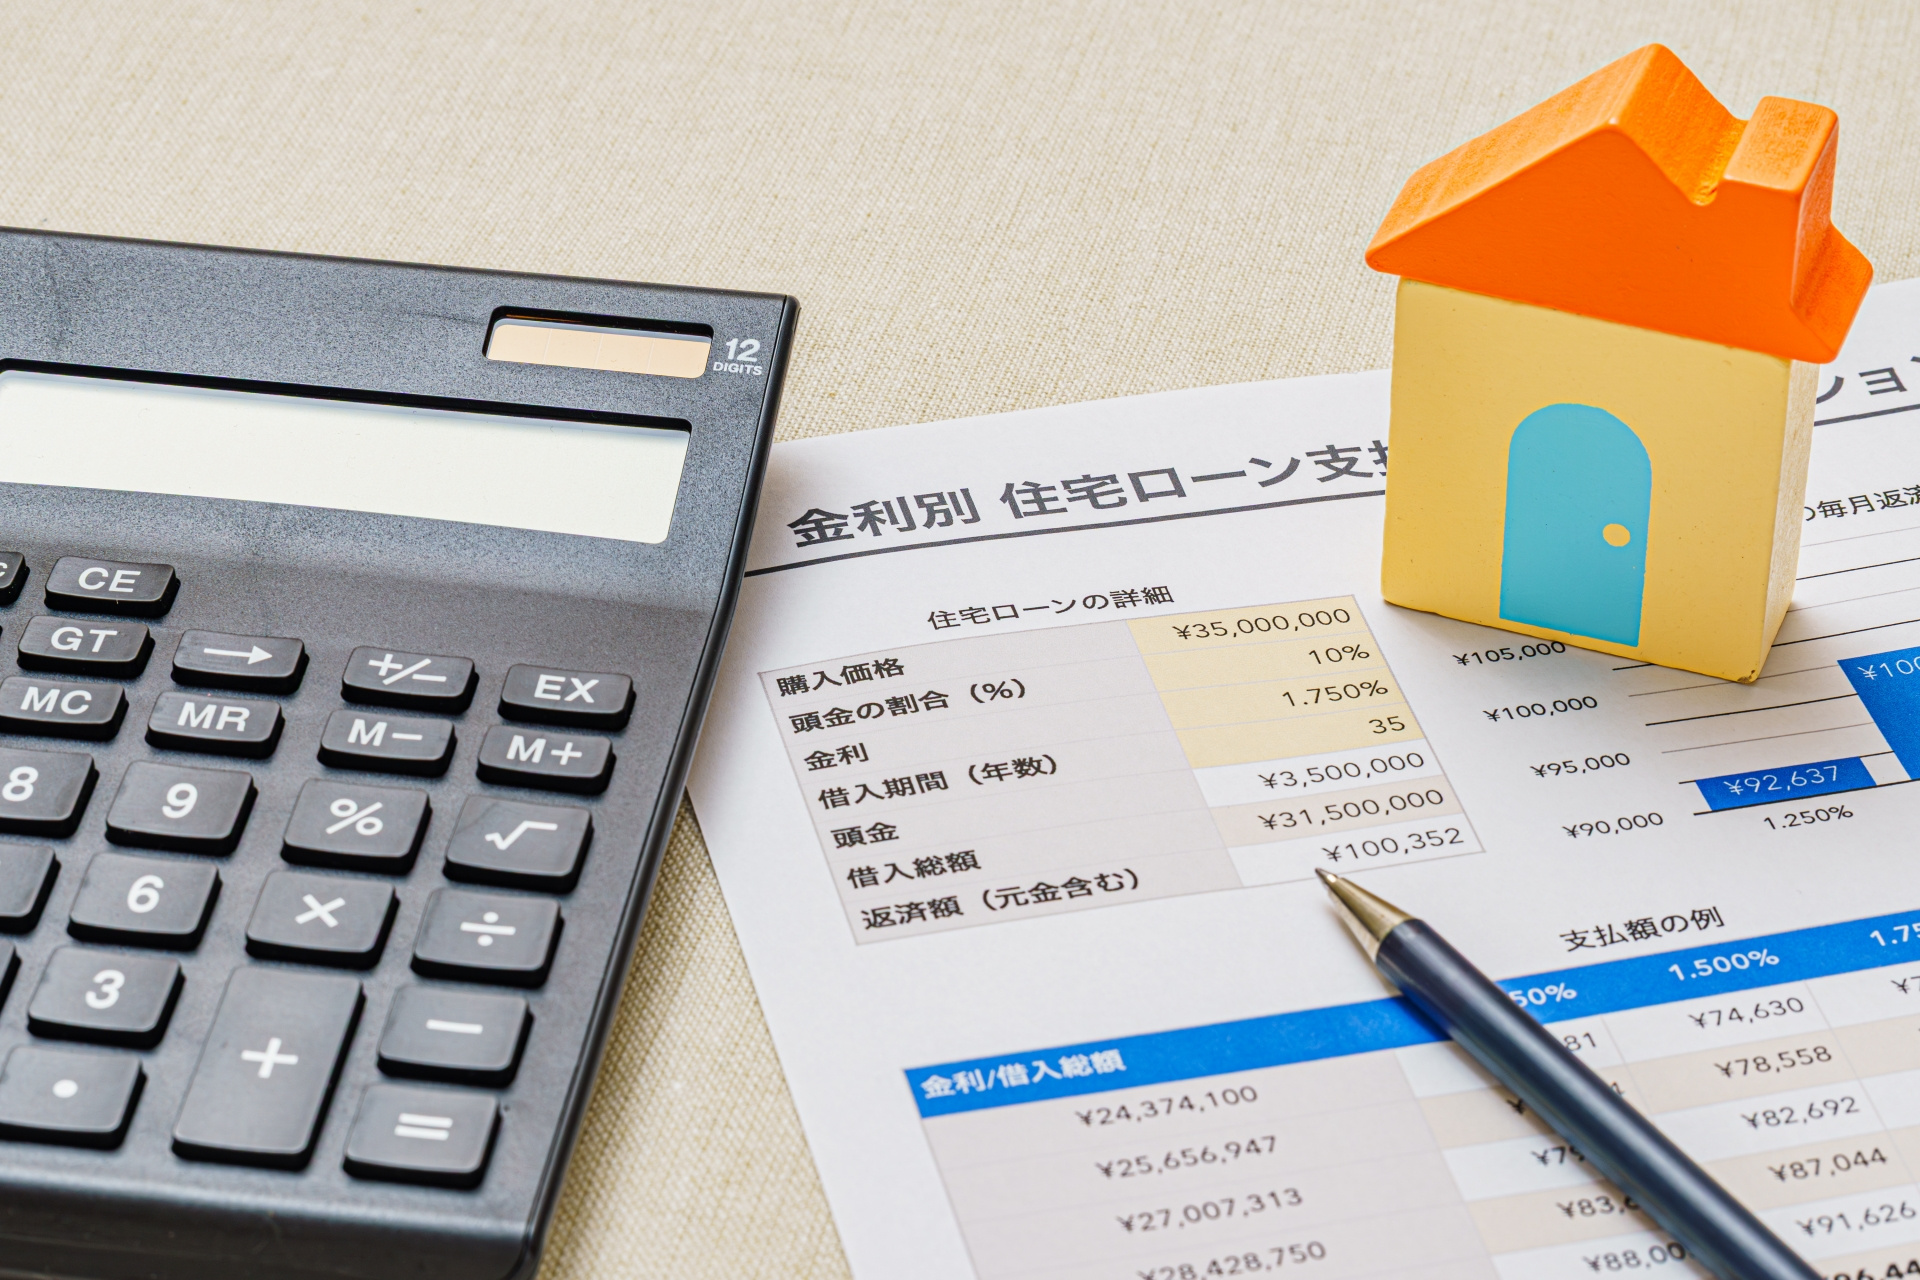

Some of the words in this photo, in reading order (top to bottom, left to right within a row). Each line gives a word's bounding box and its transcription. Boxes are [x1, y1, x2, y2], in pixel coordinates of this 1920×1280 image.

[726, 338, 761, 362] 12
[713, 361, 763, 376] DIGITS
[787, 485, 983, 549] 金利別
[78, 567, 141, 592] CE
[926, 585, 1175, 631] 住宅ローンの詳細
[1172, 608, 1352, 640] ¥35,000,000
[50, 626, 118, 654] GT
[1308, 644, 1371, 665] 10%
[1452, 640, 1567, 667] ¥105,000
[534, 675, 600, 703] EX
[775, 656, 906, 697] 購入価格
[1282, 679, 1389, 707] 1.750%
[20, 686, 92, 715] MC
[178, 702, 251, 732] MR
[1483, 694, 1599, 723] ¥100,000
[1368, 715, 1406, 734] 35
[506, 735, 582, 764] M+
[803, 741, 870, 771] 金利
[1530, 752, 1631, 779] ¥95,000
[2, 766, 39, 802] 8
[818, 753, 1058, 810] 借入期間（年数）
[1258, 752, 1425, 789] ¥3,500,000
[1723, 765, 1839, 795] ¥92,637
[161, 782, 198, 819] 9
[326, 798, 384, 837] %
[1258, 788, 1444, 830] ¥31,500,000
[1763, 804, 1854, 831] 1.250%
[830, 821, 900, 849] 頭金
[1562, 811, 1664, 839] ¥90,000
[1322, 827, 1465, 862] ¥100,352
[846, 849, 982, 889] 借入総額
[126, 875, 165, 913] 6
[861, 867, 1140, 930] 返済額（元金含む）
[1560, 905, 1725, 952] 支払額の例
[1668, 948, 1780, 982] 1.500%
[85, 969, 125, 1009] 3
[1688, 997, 1805, 1029] ¥74,630
[920, 1048, 1127, 1100] 金利/借入総額
[1714, 1045, 1832, 1079] ¥78,558
[1075, 1085, 1259, 1128] ¥24,374,100
[1740, 1096, 1861, 1130] ¥82,692
[1095, 1134, 1279, 1179] ¥25,656,947
[1767, 1147, 1888, 1184] ¥87,044
[1116, 1187, 1304, 1235] ¥27,007,313
[1795, 1201, 1917, 1237] ¥91,626
